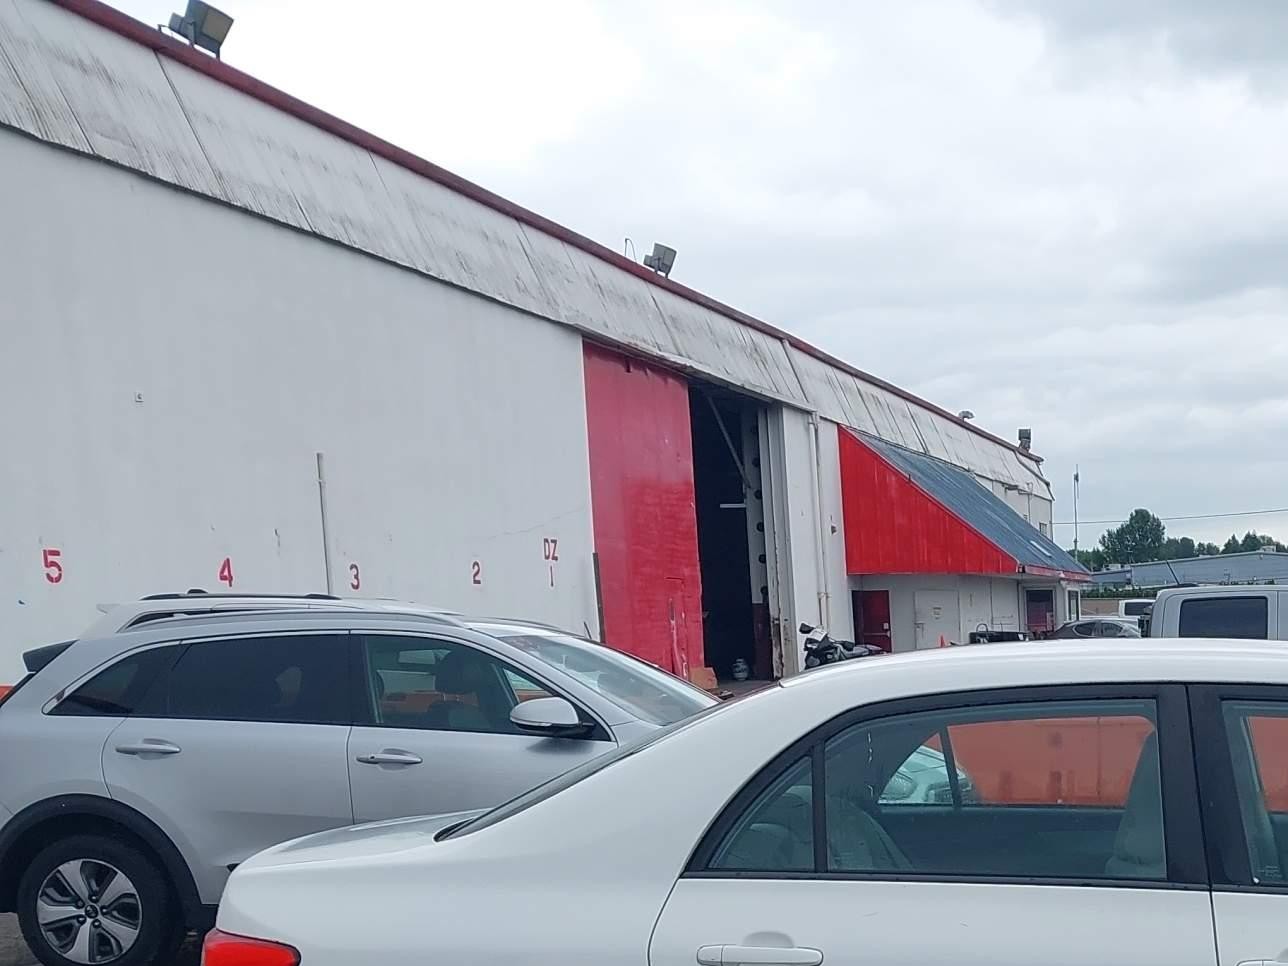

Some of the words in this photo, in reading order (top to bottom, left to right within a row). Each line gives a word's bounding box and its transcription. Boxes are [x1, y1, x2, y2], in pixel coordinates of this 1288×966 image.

[43, 549, 62, 583] 5
[219, 557, 234, 587] 4
[349, 563, 360, 590] 3
[472, 560, 482, 585] 2
